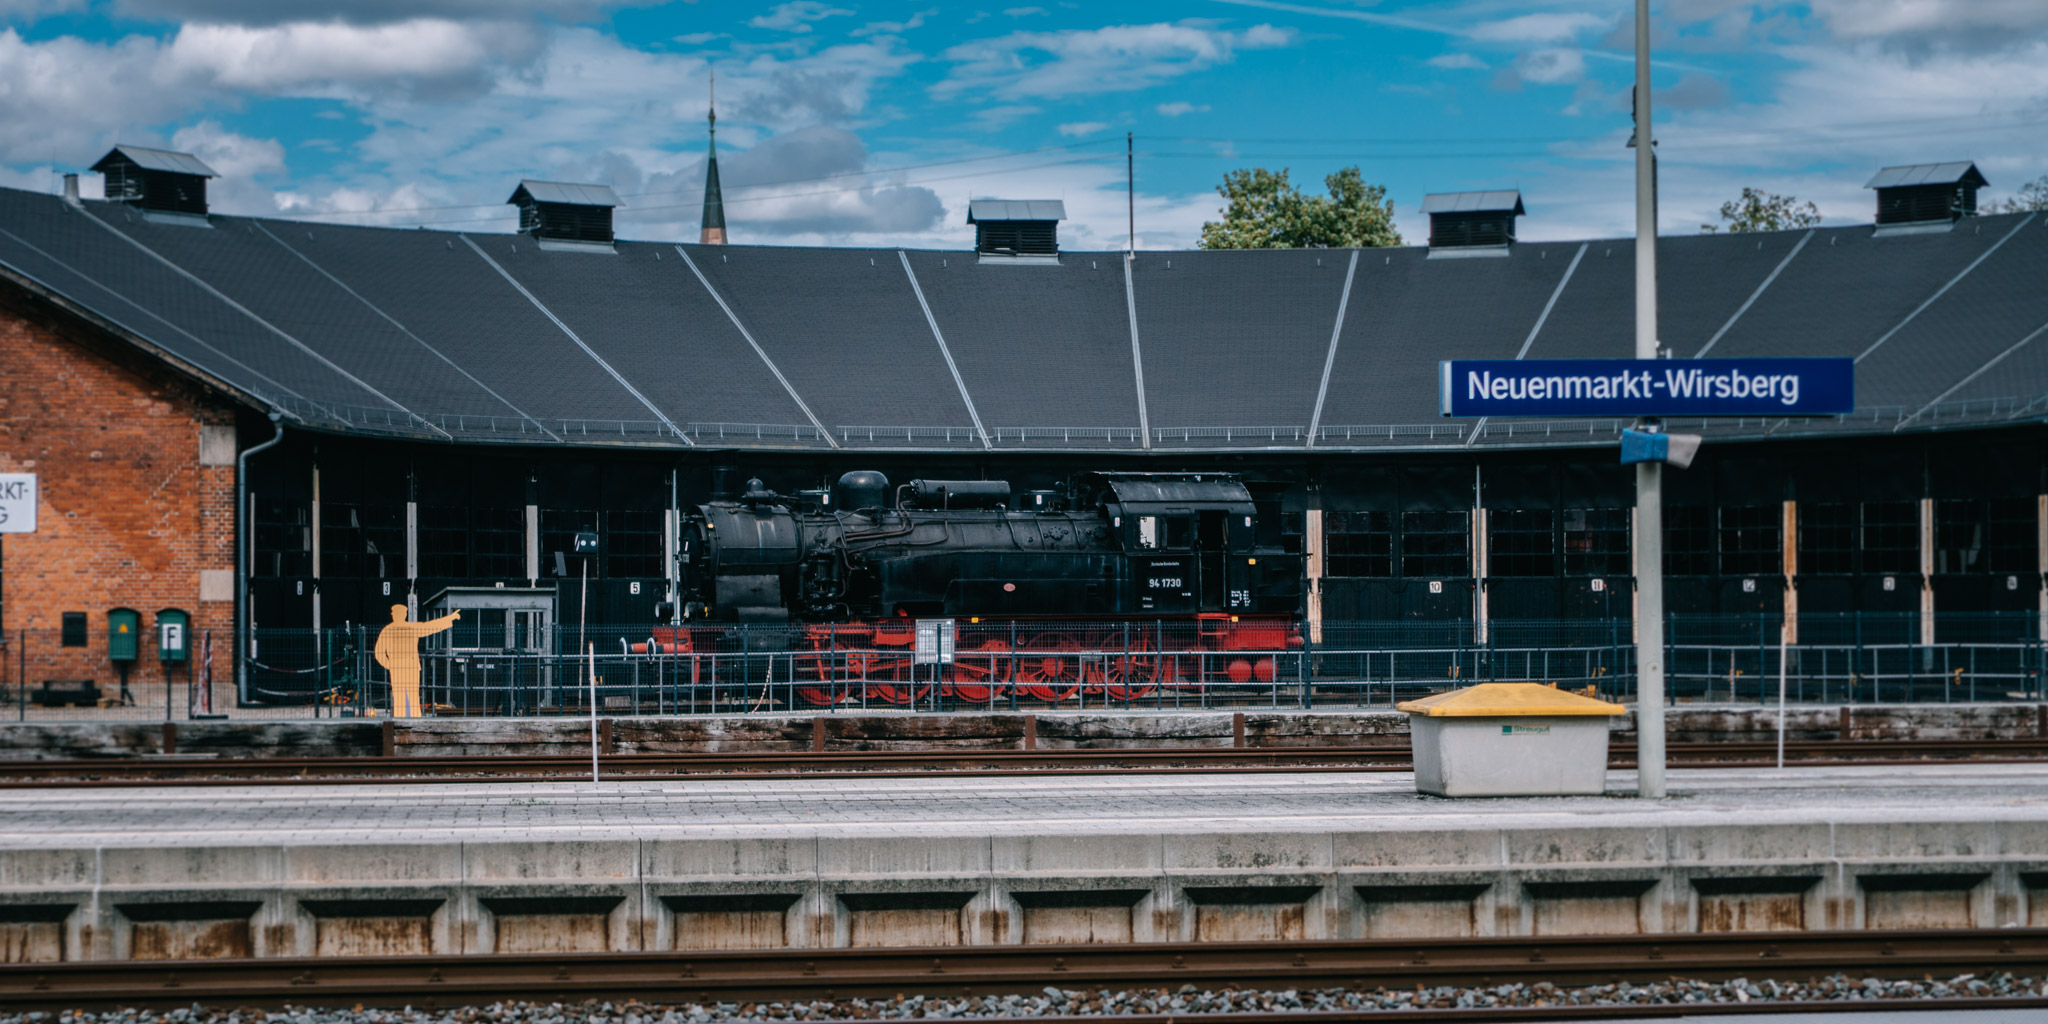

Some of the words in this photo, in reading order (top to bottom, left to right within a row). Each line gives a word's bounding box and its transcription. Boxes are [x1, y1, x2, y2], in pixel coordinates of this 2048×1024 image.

[1468, 369, 1800, 405] Neuenmarkt-Wirsberg
[632, 583, 639, 594] 5
[1149, 578, 1160, 588] 94
[1161, 578, 1181, 588] 1730
[1430, 582, 1440, 592] 10
[167, 626, 176, 648] F
